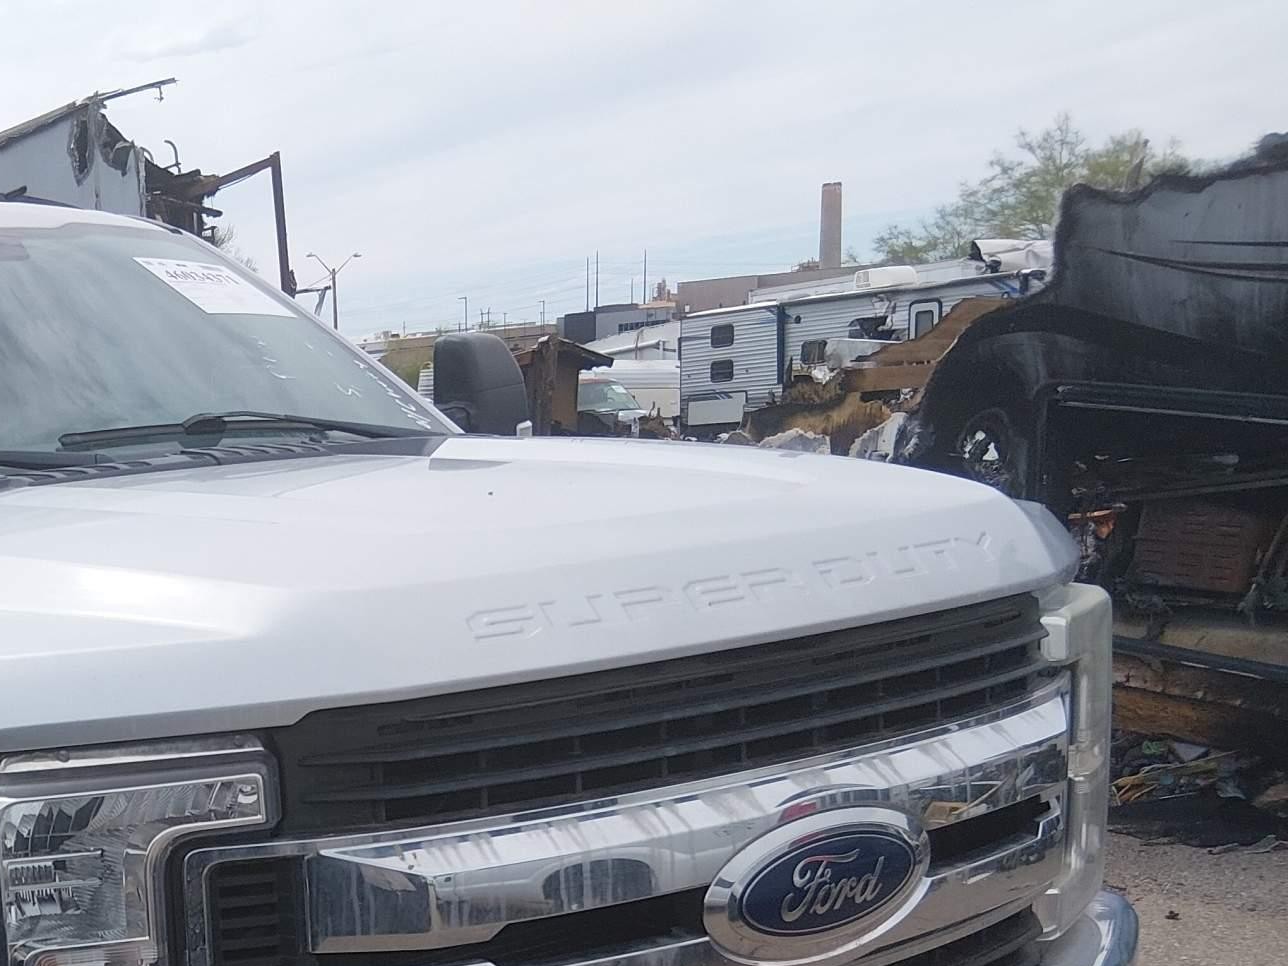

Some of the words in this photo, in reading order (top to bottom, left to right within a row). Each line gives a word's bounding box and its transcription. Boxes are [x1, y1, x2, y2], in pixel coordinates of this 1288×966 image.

[464, 567, 805, 641] SUPER
[812, 531, 996, 589] DUTY
[781, 848, 884, 922] Ford
